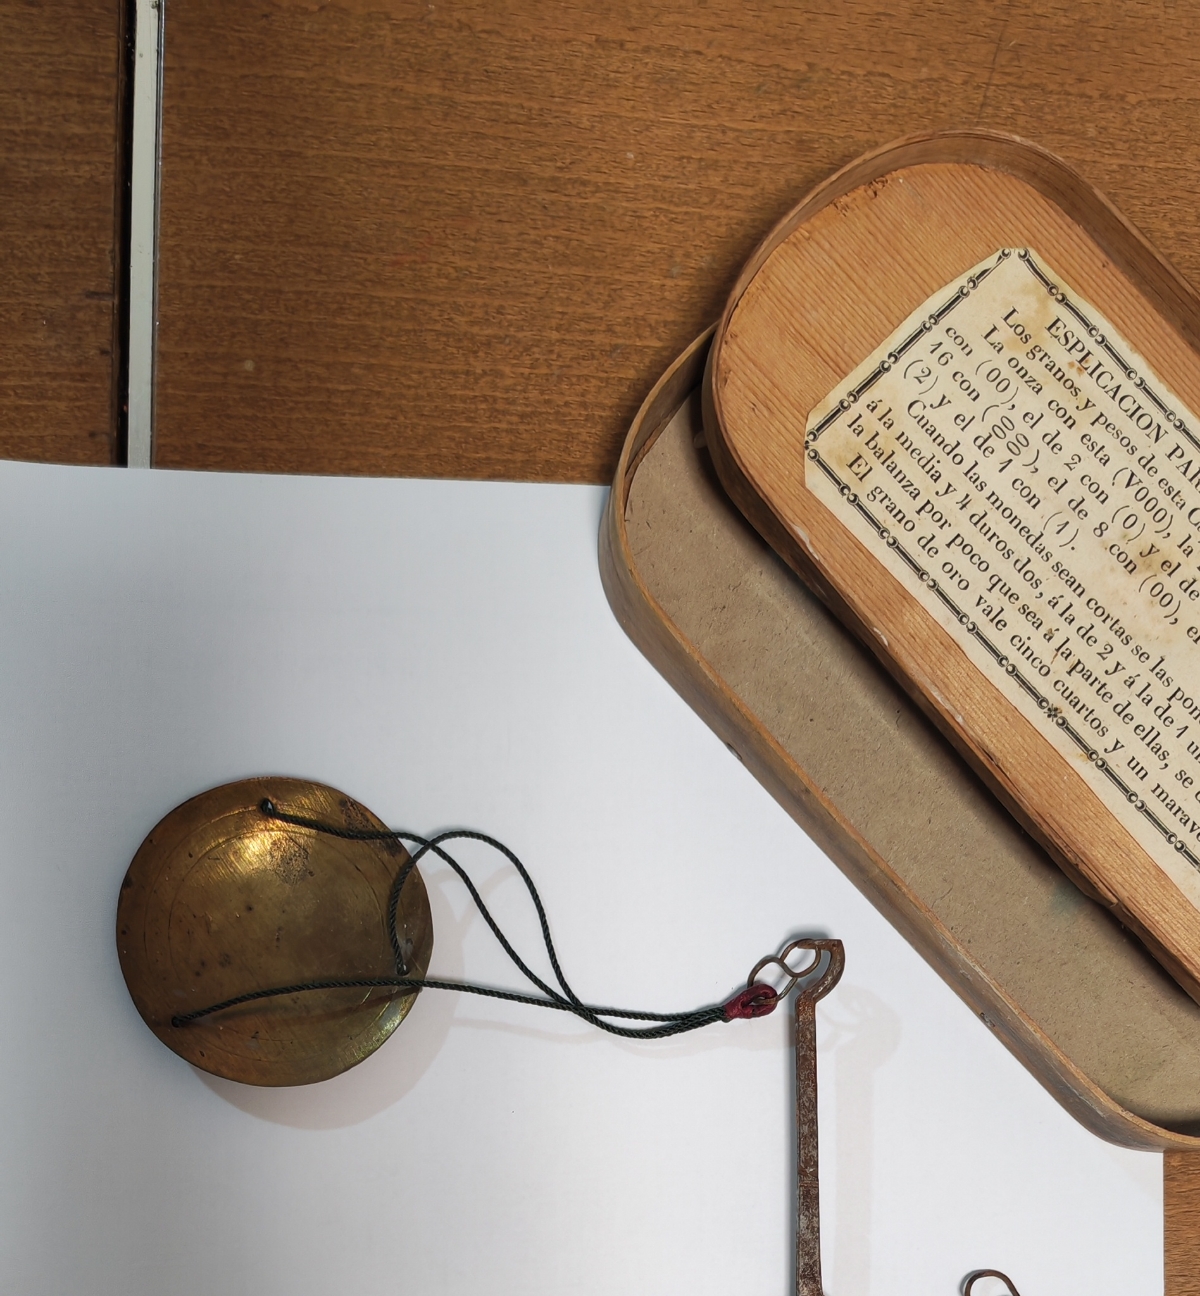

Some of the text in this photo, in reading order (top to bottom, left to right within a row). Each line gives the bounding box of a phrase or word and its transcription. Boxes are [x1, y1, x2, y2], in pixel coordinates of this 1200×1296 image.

[1044, 317, 1169, 444] ESPLICACION
[866, 399, 883, 414] á
[877, 406, 895, 431] la
[1002, 306, 1032, 345] Los
[1075, 397, 1097, 411] y
[1089, 411, 1138, 456] pesos
[1137, 453, 1158, 478] de
[1157, 477, 1186, 511] esta
[1187, 507, 1200, 532] C
[983, 323, 1004, 355] La
[1007, 357, 1043, 396] onza
[1047, 399, 1077, 430] con
[1080, 433, 1111, 467] esta
[1176, 533, 1194, 558] la
[894, 431, 942, 484] media
[903, 359, 1079, 551] (2) y el de 1 con (1).
[945, 327, 1200, 601] con (00), el de 2 con (0) y el de
[929, 341, 954, 366] 16
[952, 371, 980, 402] con
[1047, 476, 1069, 495] el
[1067, 496, 1089, 521] de
[1092, 521, 1109, 538] 8
[1108, 543, 1137, 575] con
[1138, 574, 1181, 625] (00),
[935, 481, 957, 497] y
[955, 493, 972, 511] 4
[968, 509, 1015, 560] duros
[907, 399, 1200, 723] Cuando las monedas sean cortas se las pon
[846, 413, 1194, 789] la balanza por poco que sea á la parte de ellas, se
[1047, 594, 1065, 610] á
[1058, 602, 1076, 626] la
[845, 451, 873, 483] El
[866, 486, 916, 532] grano
[917, 533, 939, 558] de
[941, 561, 970, 591] oro
[975, 594, 1008, 632] vale
[1009, 634, 1051, 677] cinco
[1053, 679, 1109, 738] cuartos
[1103, 738, 1125, 754] y
[1126, 755, 1149, 781] un
[1076, 623, 1098, 647] de
[1096, 643, 1114, 661] 2
[1104, 660, 1126, 676] y
[1123, 673, 1141, 690] á
[1135, 681, 1153, 707] la
[1153, 702, 1175, 728] de
[1176, 725, 1189, 739] 1
